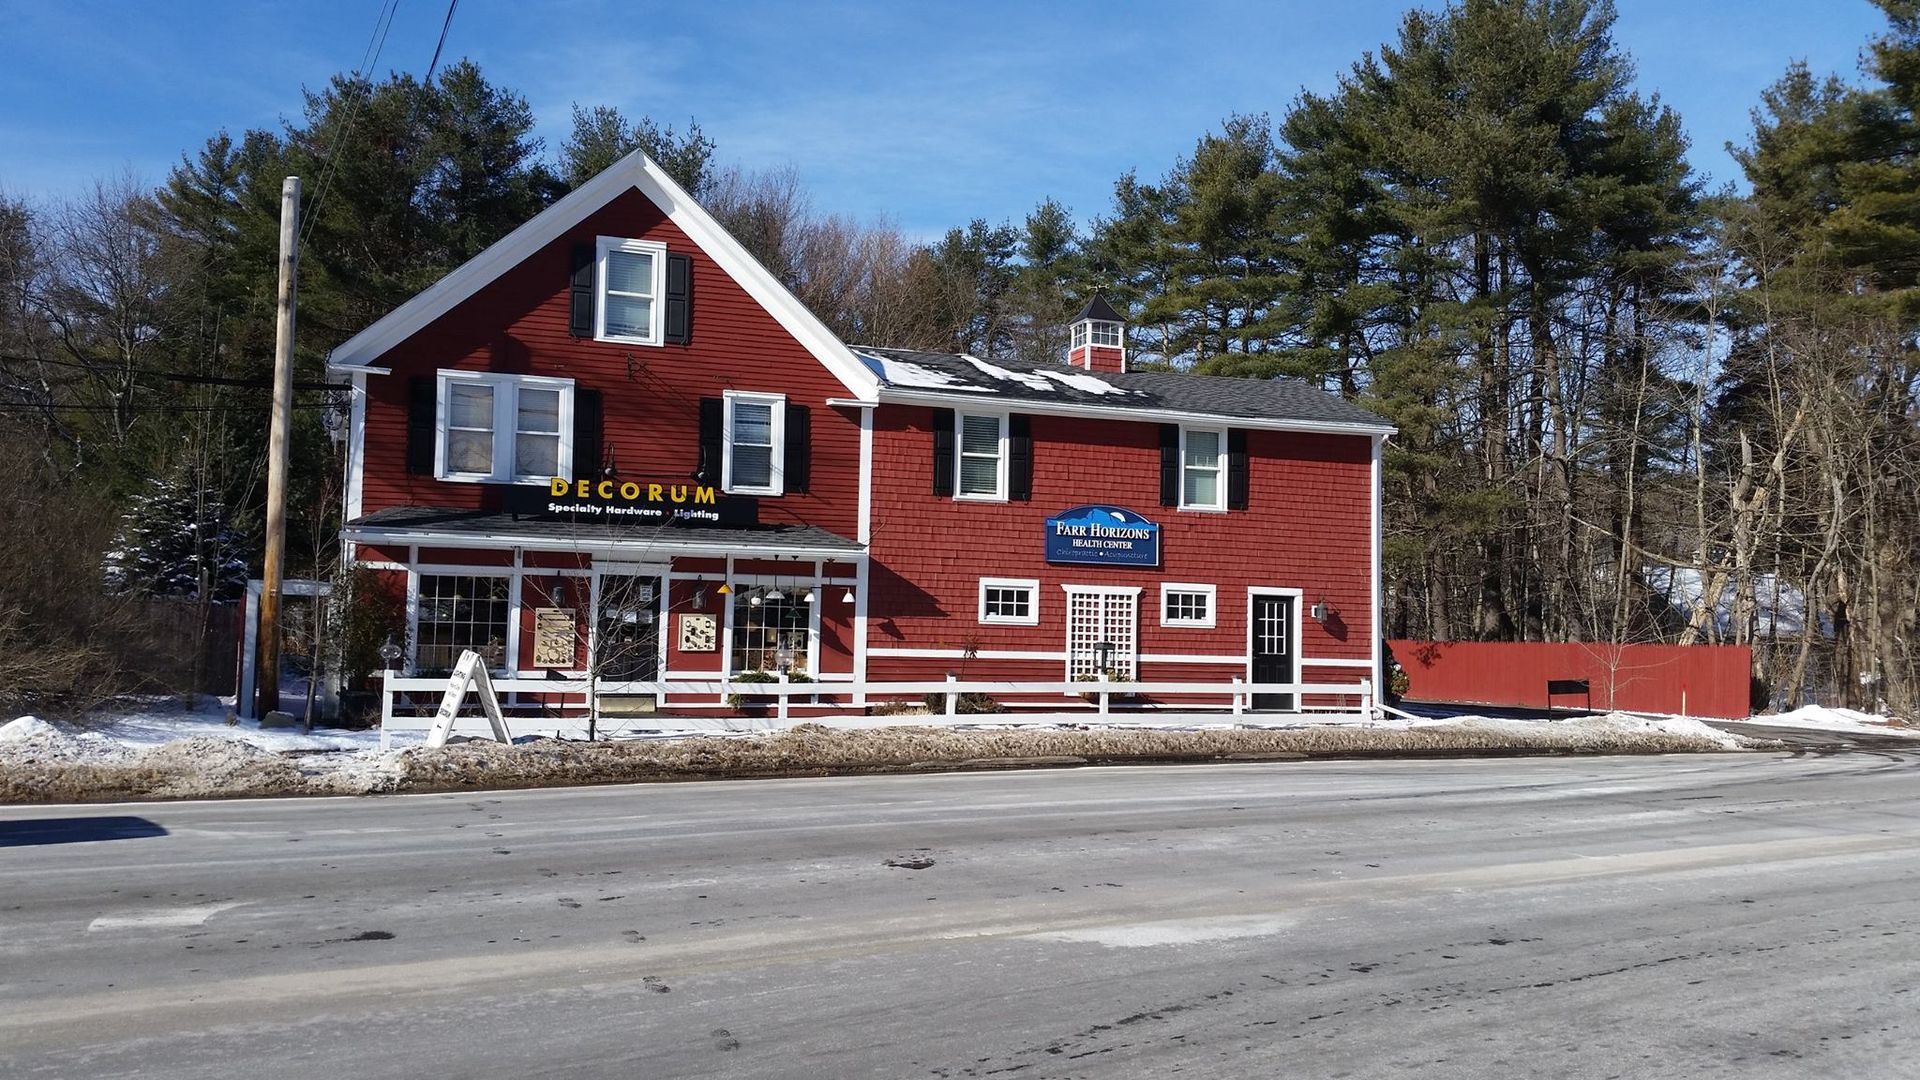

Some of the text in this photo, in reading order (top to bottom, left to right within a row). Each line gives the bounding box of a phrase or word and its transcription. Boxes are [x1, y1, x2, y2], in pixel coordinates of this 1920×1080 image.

[550, 478, 716, 504] DECORUM
[548, 502, 719, 521] Specialty Hardware Lighting
[1056, 521, 1150, 540] FARR HORIZONS
[1056, 548, 1098, 558] Chiropractic
[1072, 539, 1133, 550] HEALTH CENTER
